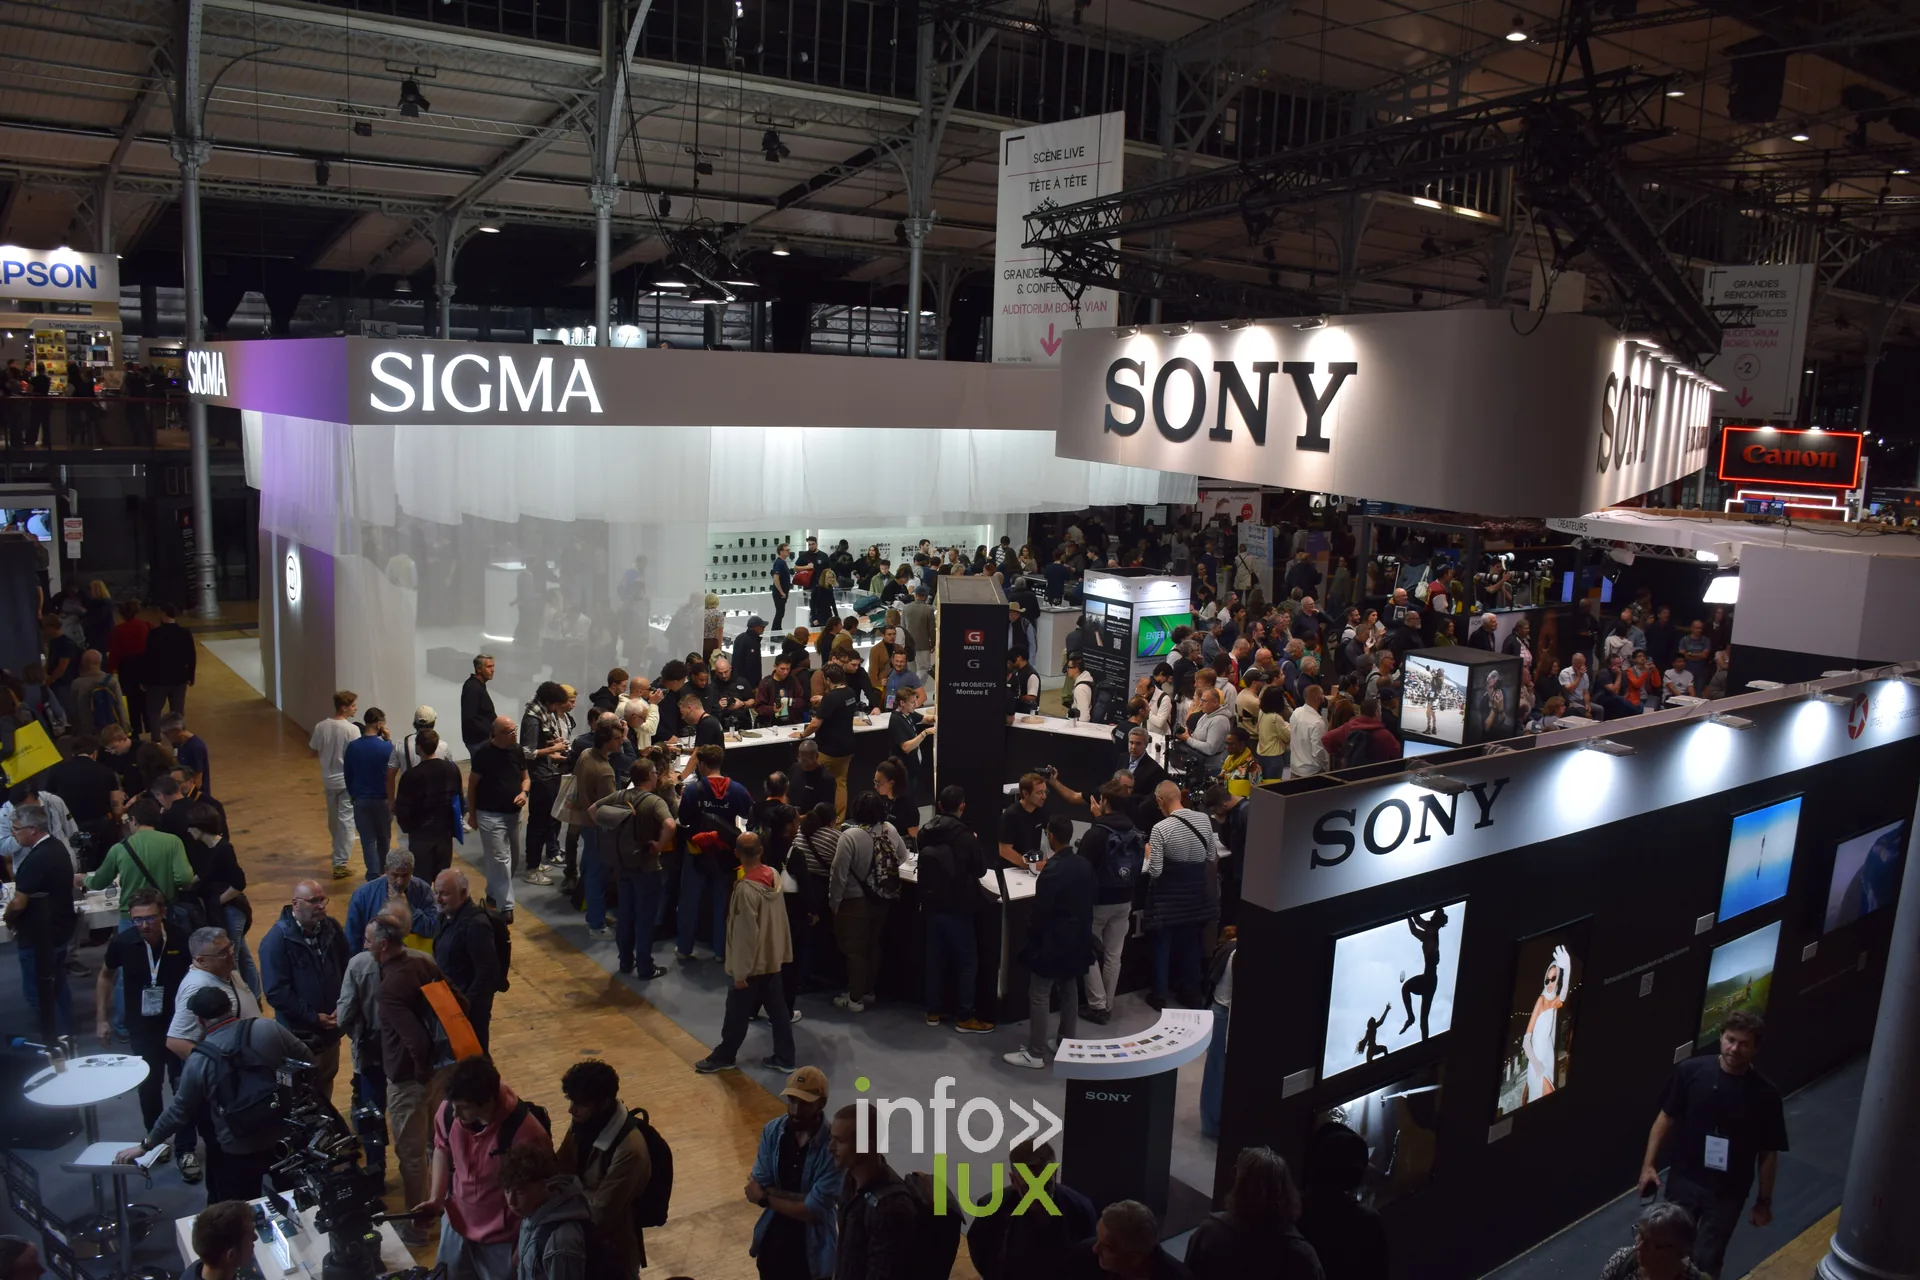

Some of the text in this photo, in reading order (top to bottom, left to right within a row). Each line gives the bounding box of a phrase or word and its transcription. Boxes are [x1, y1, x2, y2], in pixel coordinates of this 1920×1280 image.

[1033, 146, 1085, 164] SCÈNE LIVE
[1029, 174, 1088, 193] TÊTE À TÊTE
[0, 260, 97, 289] PSON
[1017, 283, 1024, 295] &
[1733, 279, 1780, 289] GRANDES
[1724, 290, 1787, 299] RENCONTRES
[1002, 303, 1053, 316] AUDITORIUM
[1084, 300, 1108, 313] VIAN
[1722, 328, 1780, 338] AUDITORIUM
[1723, 339, 1778, 348] BORIS VIAN
[187, 350, 228, 397] SIGMA
[370, 351, 603, 412] SIGMA
[1104, 357, 1358, 453] SONY
[1597, 371, 1656, 474] SONY
[1742, 444, 1838, 469] Canon
[967, 631, 981, 643] G
[1145, 630, 1165, 640] ENTER
[966, 659, 981, 669] G
[969, 681, 997, 689] OBJECTIFS
[956, 688, 983, 696] Monture
[1310, 777, 1510, 870] SONY
[1085, 1091, 1132, 1103] SONY
